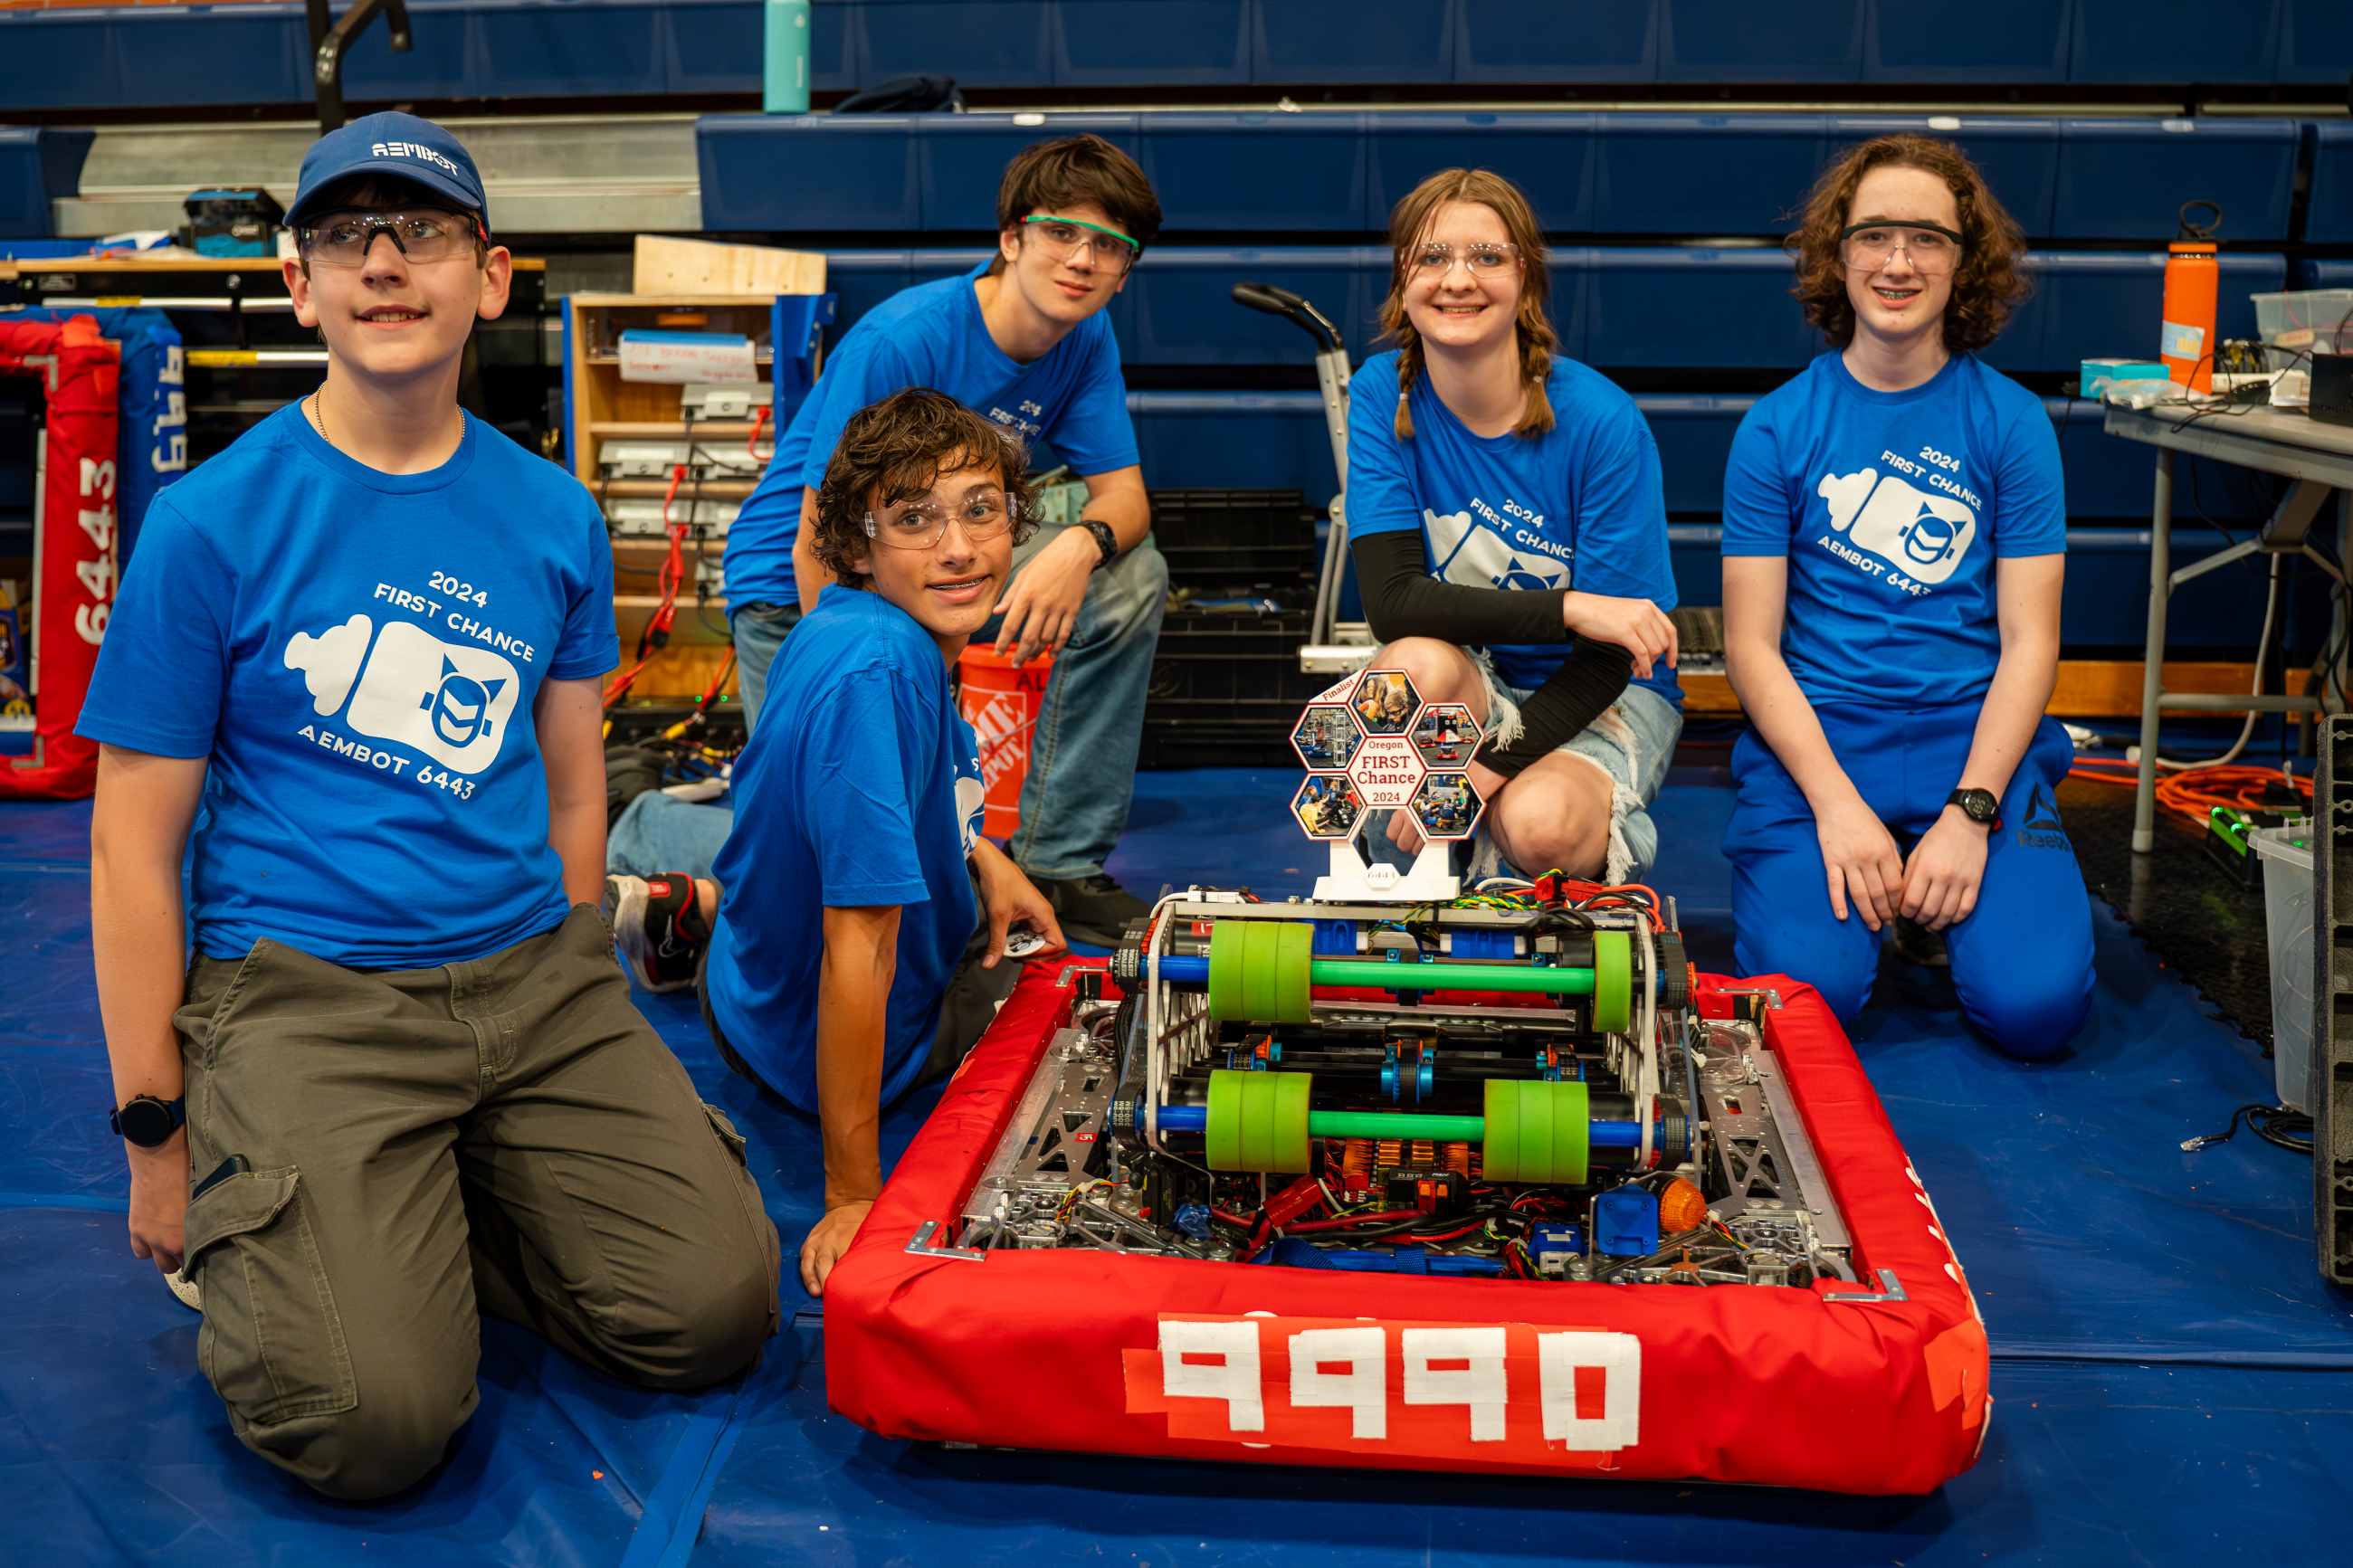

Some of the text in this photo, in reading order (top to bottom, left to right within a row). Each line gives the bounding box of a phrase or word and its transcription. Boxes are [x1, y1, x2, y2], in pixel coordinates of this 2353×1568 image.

[1919, 446, 1961, 473] 2024
[1881, 450, 1983, 511] FIRST CHANCE
[1470, 498, 1575, 560] FIRST CHANC
[1502, 499, 1545, 528] 2024
[74, 457, 116, 646] 6443
[1816, 535, 1885, 576] AEMBOT
[428, 571, 488, 608] 2024
[374, 583, 535, 662] FIRST CHANCE
[1323, 678, 1355, 702] Finalist
[297, 725, 476, 800] AEMBOT 6443
[1362, 756, 1411, 769] FIRST
[1368, 741, 1404, 750] Oregon
[1357, 771, 1416, 784] Chance
[1373, 792, 1401, 803] 2024
[1158, 1320, 1641, 1451] 9990
